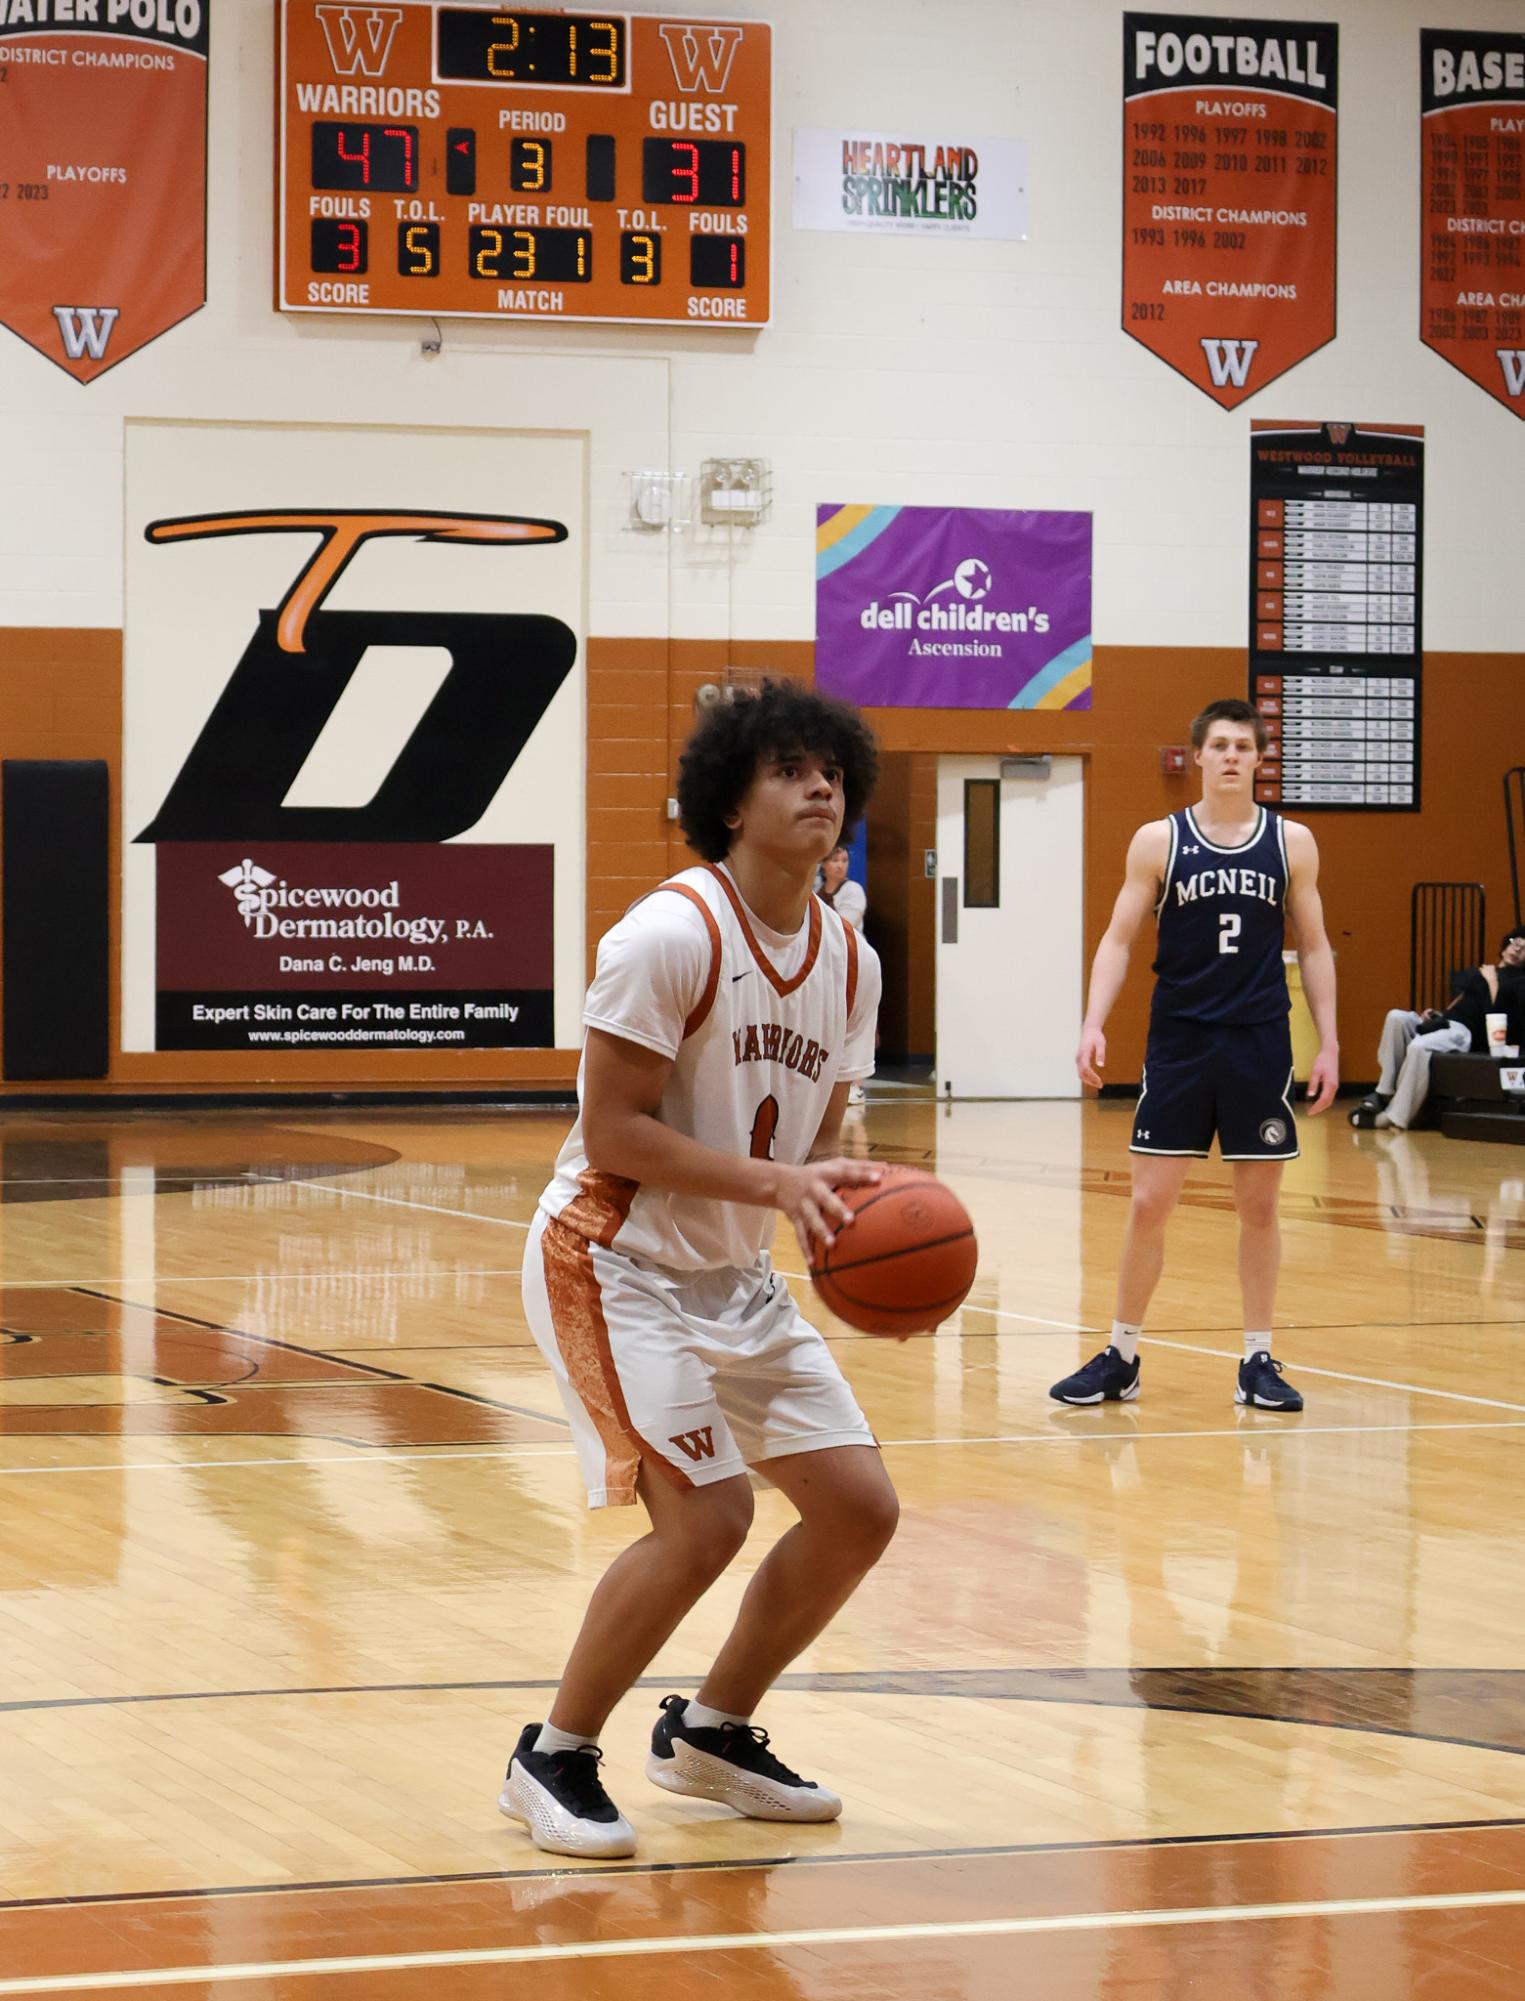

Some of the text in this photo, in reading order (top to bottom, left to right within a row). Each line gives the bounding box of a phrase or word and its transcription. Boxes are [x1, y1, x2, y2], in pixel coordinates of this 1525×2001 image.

[107, 0, 201, 39] POLO
[0, 47, 175, 71] DISTRICT CHAMPIONS
[487, 17, 617, 82] 2:13
[1136, 30, 1326, 88] FOOTBALL
[1433, 48, 1525, 96] BASE
[296, 83, 440, 119] WARRIORS
[1195, 100, 1266, 118] PLAYOFFS
[499, 109, 566, 133] PERIOD
[649, 100, 738, 132] GUEST
[1133, 123, 1166, 142] 1992
[1174, 125, 1207, 144] 1996
[1215, 127, 1247, 145] 1997
[338, 129, 412, 186] 47
[522, 142, 544, 189] 3
[841, 139, 979, 181] HEARTLAND
[1214, 153, 1247, 171] 2010
[1255, 155, 1288, 173] 2011
[1297, 157, 1328, 175] 2012
[46, 165, 127, 184] PLAYOFFS
[672, 143, 740, 203] 31
[17, 184, 48, 200] 2023
[842, 175, 977, 220] SPRINKLERS
[309, 196, 371, 218] FOULS
[393, 199, 446, 221] T.O.L.
[468, 203, 593, 227] PLAYER FOUL
[1151, 205, 1308, 226] DISTRICT CHAMPIONS
[617, 209, 667, 231] T.O.L.
[689, 212, 748, 234] FOULS
[1447, 217, 1504, 234] DISTRICT
[338, 224, 361, 271] 3
[406, 227, 432, 273] 5
[476, 229, 535, 277] 23
[632, 236, 654, 283] 3
[730, 243, 737, 283] 1
[307, 281, 369, 305] SCORE
[497, 289, 564, 311] MATCH
[1162, 280, 1296, 299] AREA CHAMPIONS
[1456, 292, 1495, 306] AREA
[687, 296, 746, 318] SCORE
[1131, 303, 1165, 321] 2012
[51, 305, 120, 360] W
[1199, 338, 1259, 388] W
[1257, 449, 1417, 467] WESTWOOD VOLLEYBALL
[860, 602, 1050, 633] dell children's
[908, 638, 1002, 658] Ascension
[233, 880, 400, 917] Spicewood
[1175, 868, 1277, 907] MCNEIL
[253, 911, 494, 944] Dermatology, P.A.
[1218, 913, 1242, 954] 2
[279, 955, 436, 975] Dana C. Jeng M.D.
[192, 1002, 519, 1024] Expert Skin Care For The Entire Family
[248, 1027, 465, 1043] www.spicewooddermatology.com
[668, 1425, 715, 1461] W
